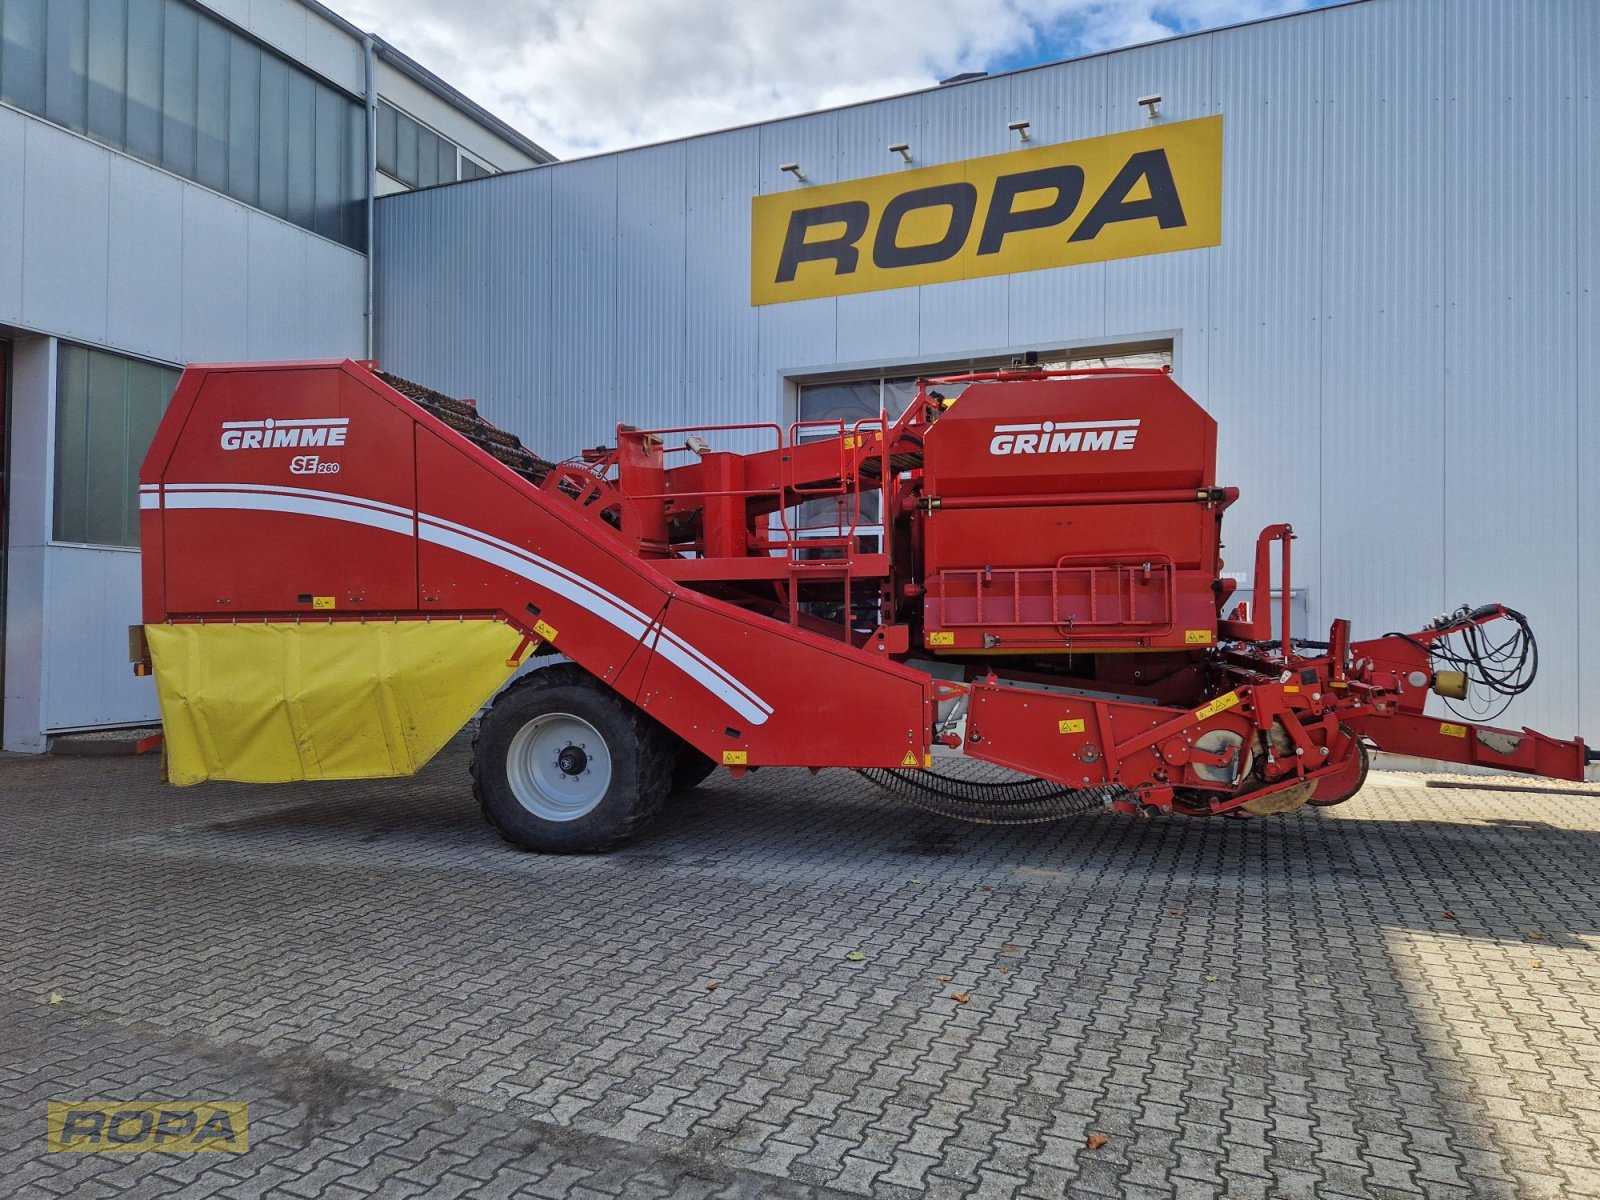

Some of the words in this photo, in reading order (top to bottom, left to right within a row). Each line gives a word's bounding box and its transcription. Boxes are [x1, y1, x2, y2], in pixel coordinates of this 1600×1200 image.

[774, 148, 1188, 284] ROPA
[220, 418, 349, 450] GRIMME
[989, 419, 1140, 455] GRIMME
[290, 456, 319, 474] SE
[318, 463, 340, 474] 260
